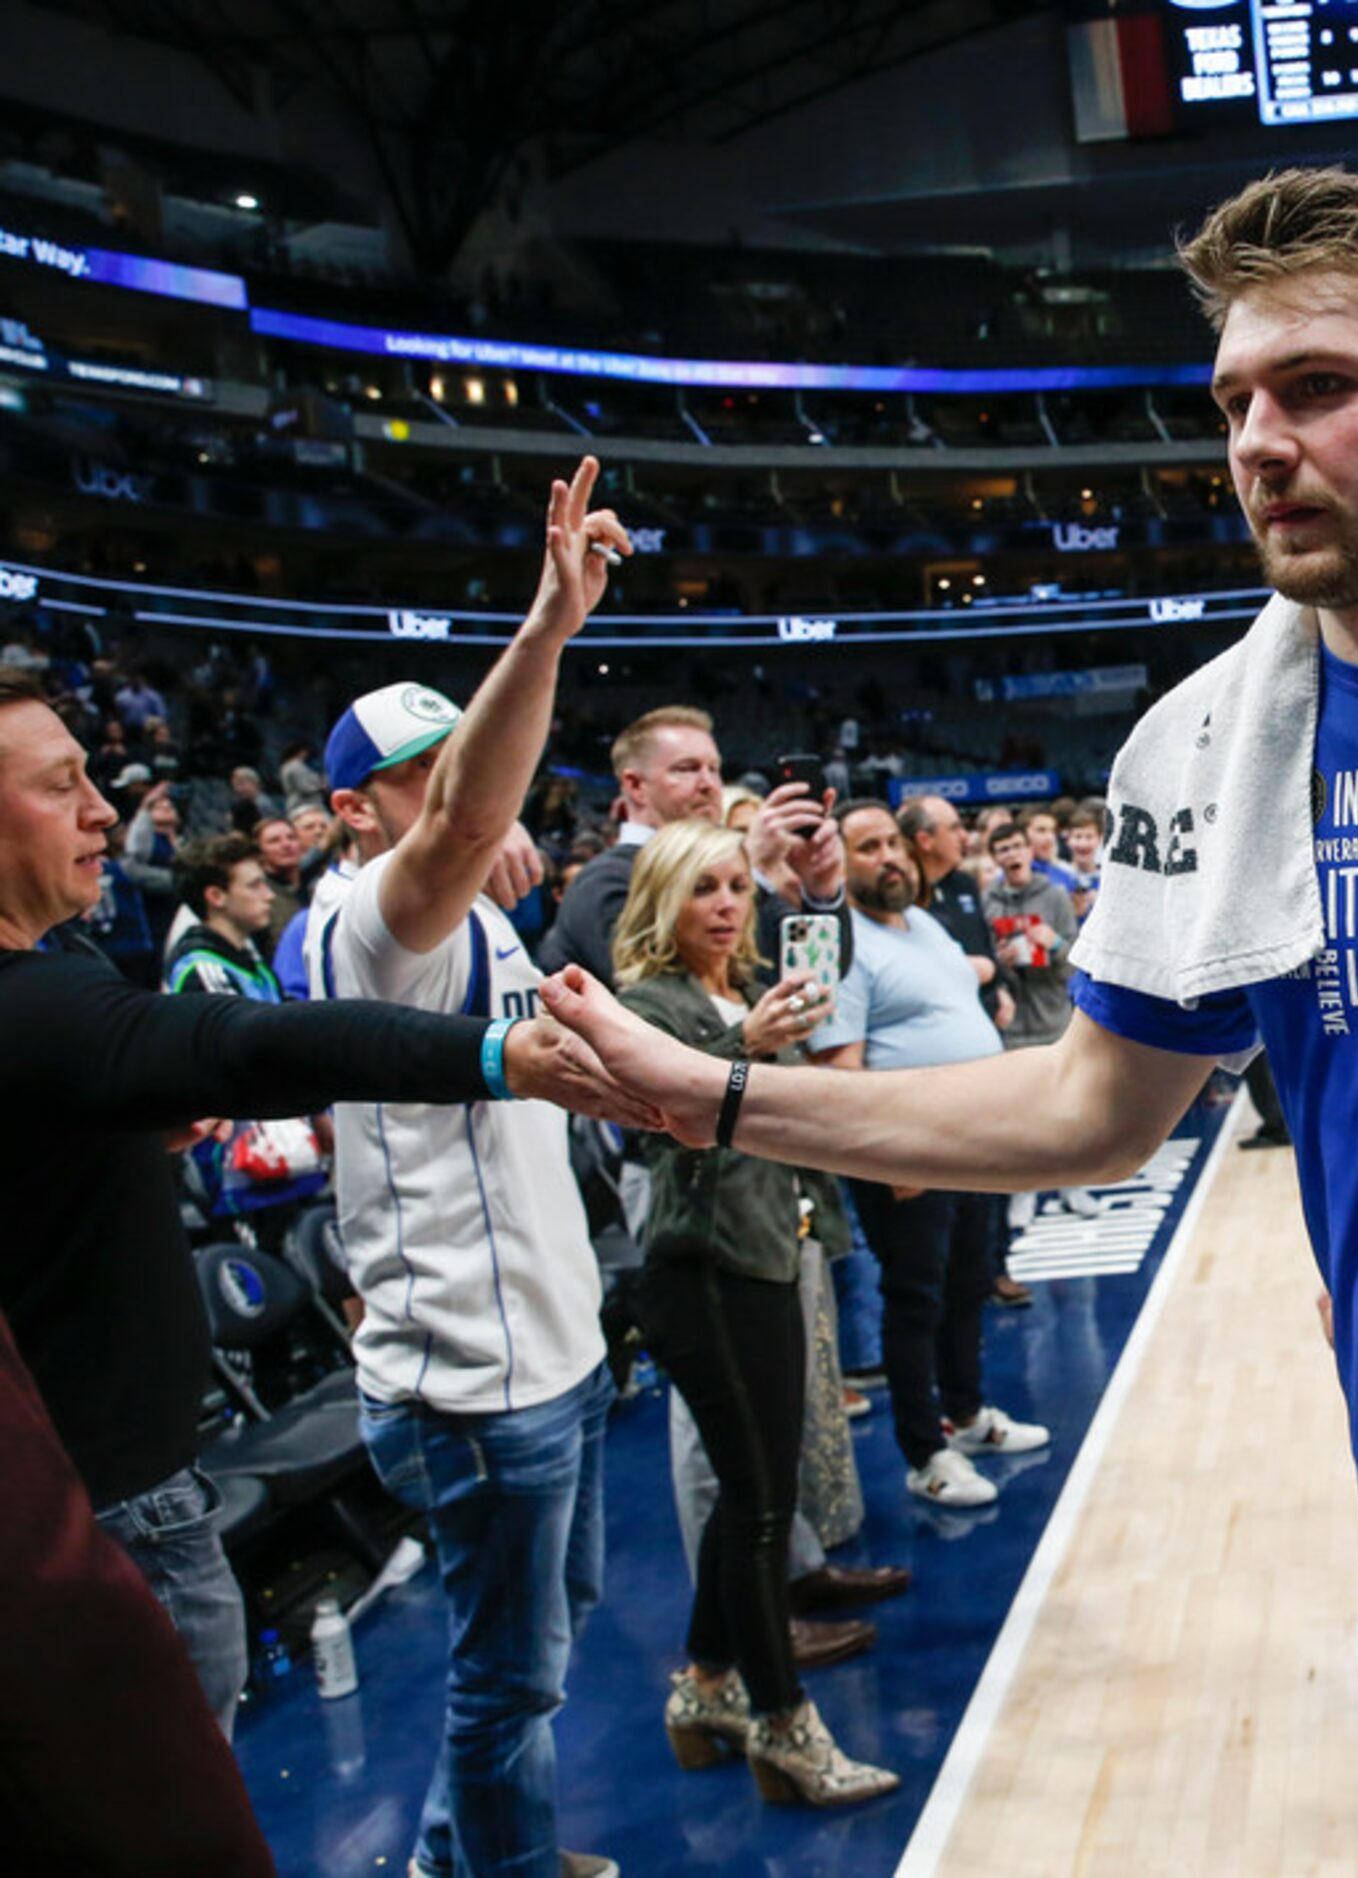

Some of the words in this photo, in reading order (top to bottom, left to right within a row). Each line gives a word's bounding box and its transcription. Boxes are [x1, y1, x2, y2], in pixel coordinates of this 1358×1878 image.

[31, 237, 91, 276] Way.
[386, 334, 450, 361] Looking
[450, 339, 473, 359] for
[1053, 522, 1118, 553] Uber
[1148, 598, 1205, 623] Uber
[388, 610, 451, 640] Uber
[777, 615, 837, 642] Uber
[987, 774, 1050, 797] GEICO
[1315, 949, 1351, 1036] BELIEVE
